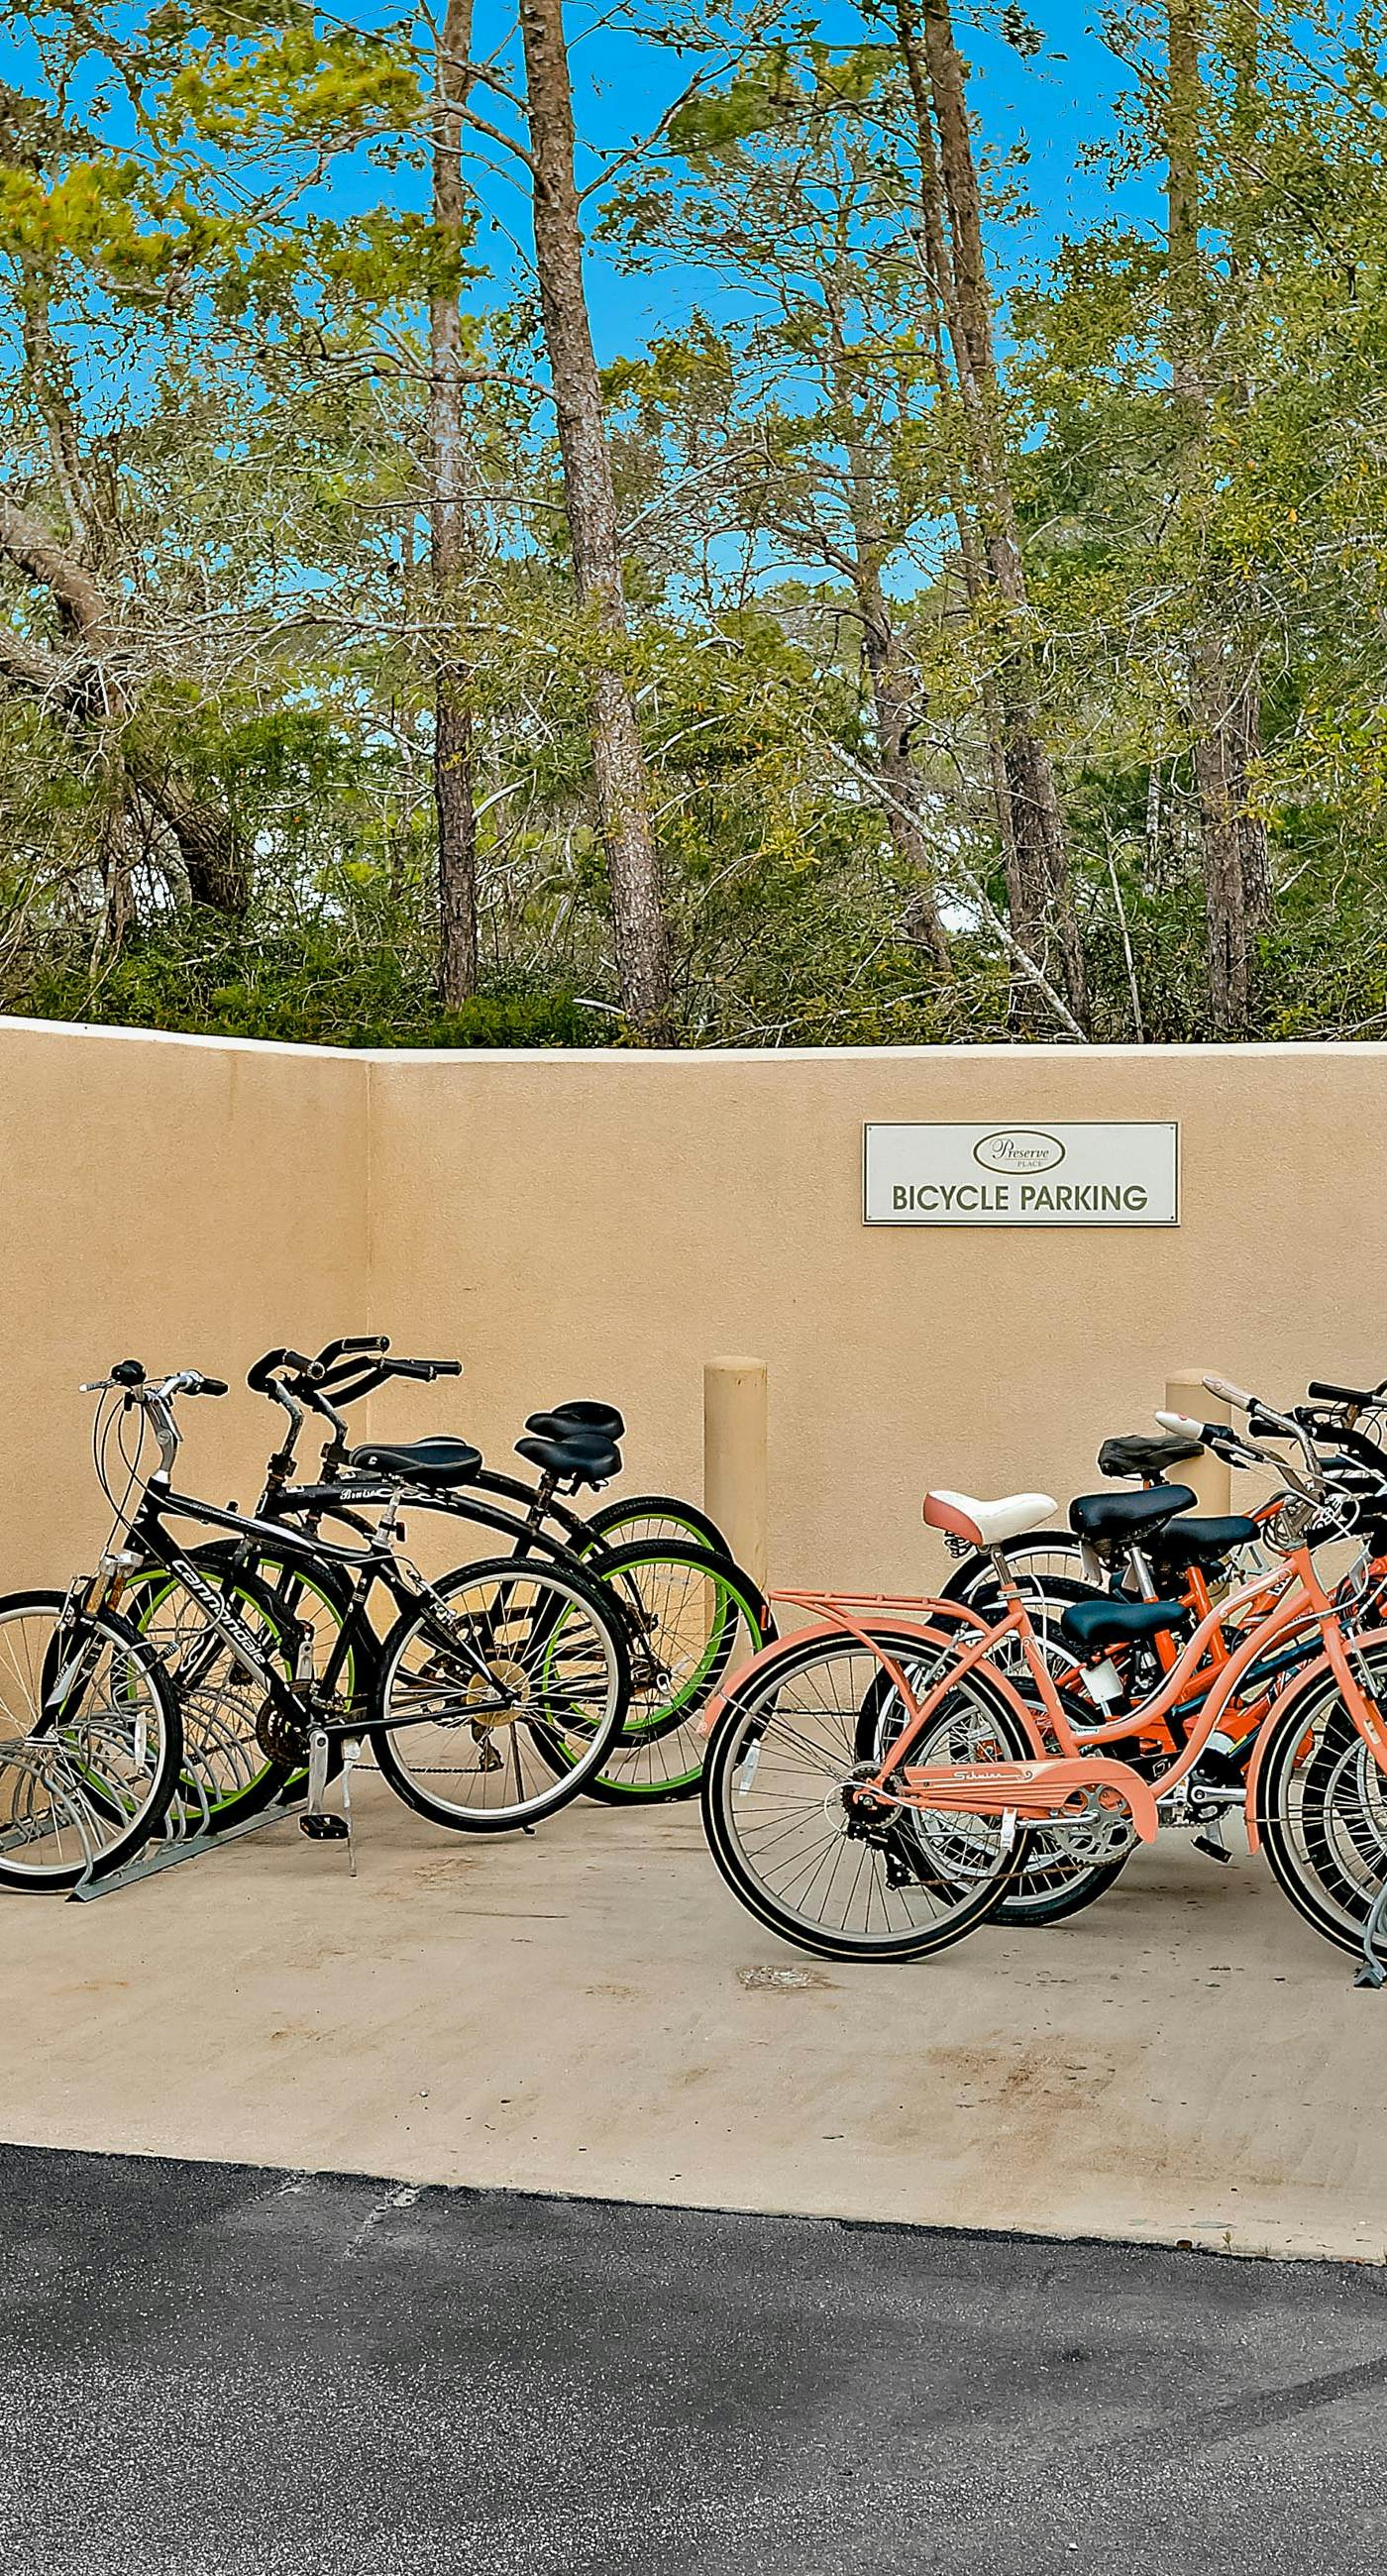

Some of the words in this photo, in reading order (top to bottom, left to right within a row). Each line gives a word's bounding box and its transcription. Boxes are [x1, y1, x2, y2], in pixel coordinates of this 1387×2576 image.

[991, 1138, 1049, 1159] Preserve
[893, 1185, 1010, 1211] BICYCLE
[1020, 1185, 1148, 1211] PARKING
